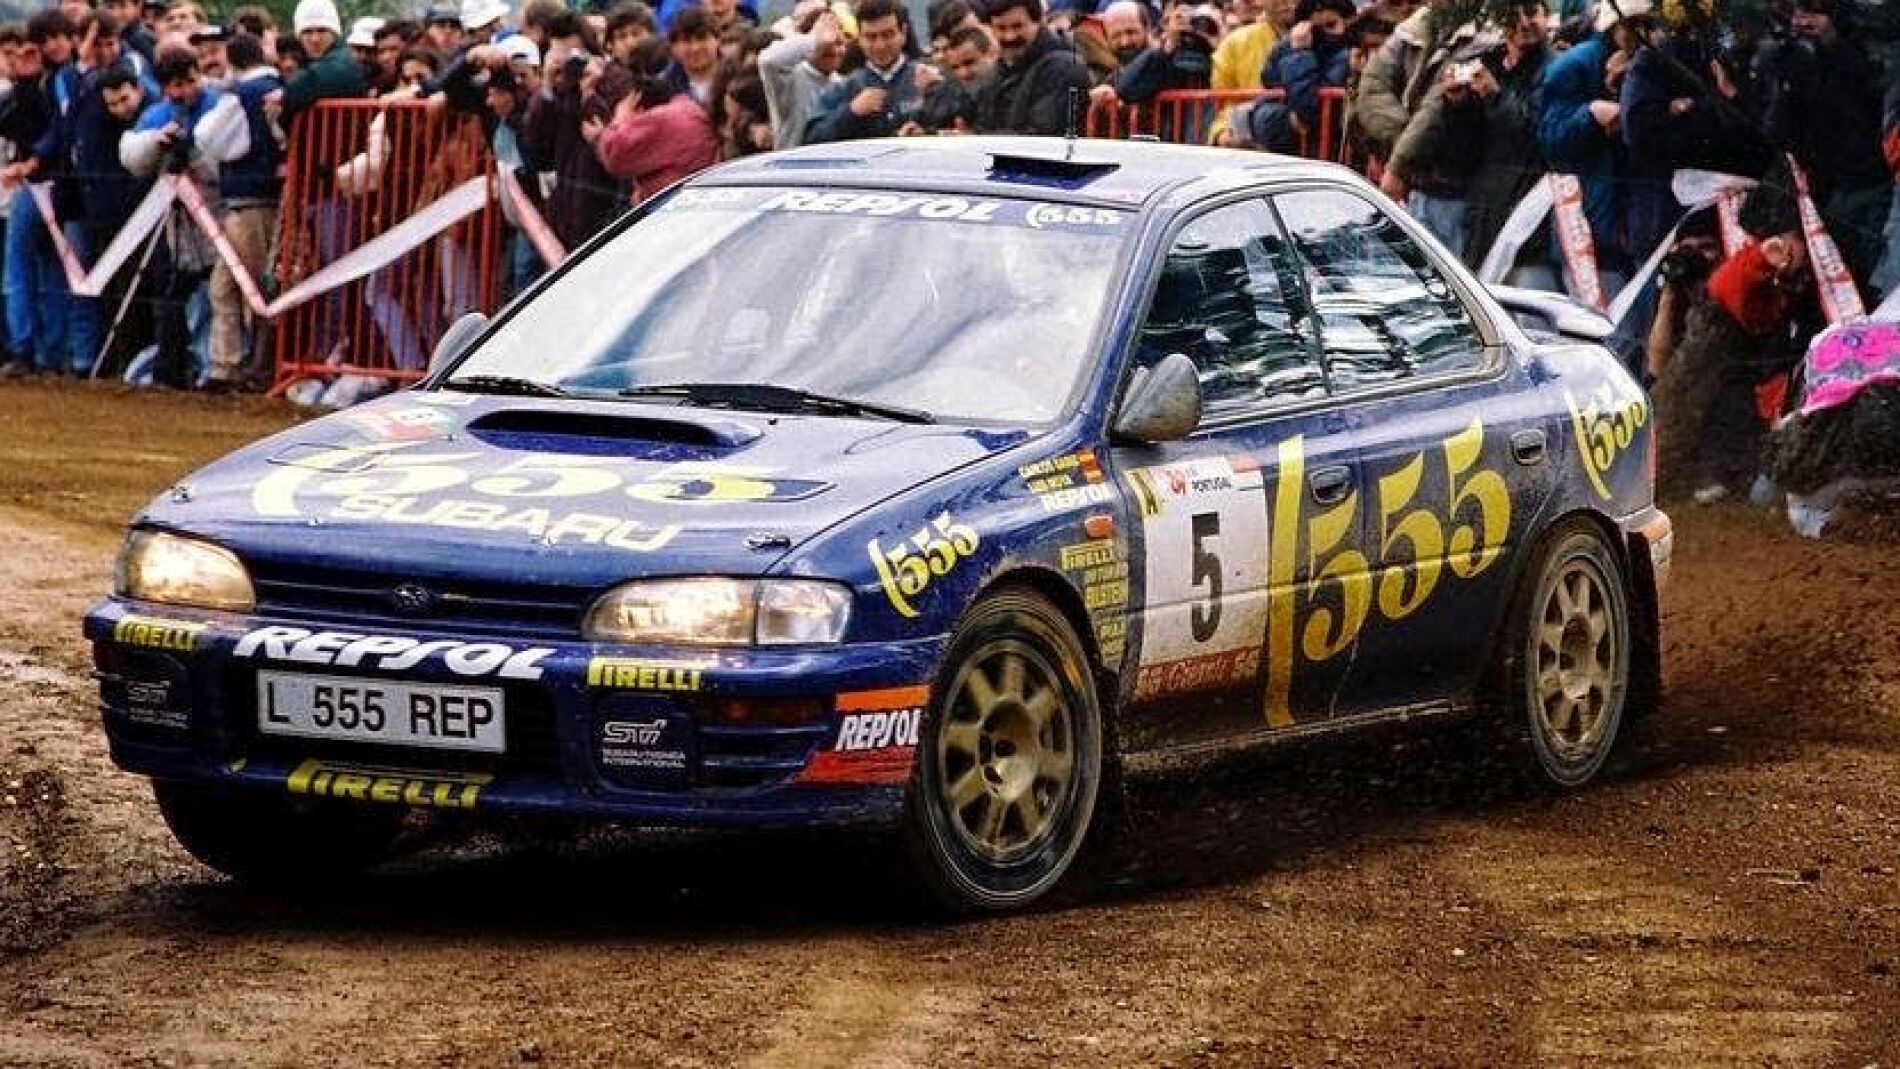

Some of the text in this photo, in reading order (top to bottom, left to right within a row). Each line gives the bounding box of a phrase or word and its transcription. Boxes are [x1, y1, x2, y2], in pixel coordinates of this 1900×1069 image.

[760, 189, 1002, 221] REPSOL
[330, 494, 684, 551] SUBARU
[1190, 511, 1223, 643] 5
[232, 625, 558, 680] REPSOL
[585, 655, 704, 692] PIRELLI
[267, 680, 494, 739] L 555 REP
[835, 708, 921, 752] REPSOL
[286, 758, 495, 810] PIRELLI
